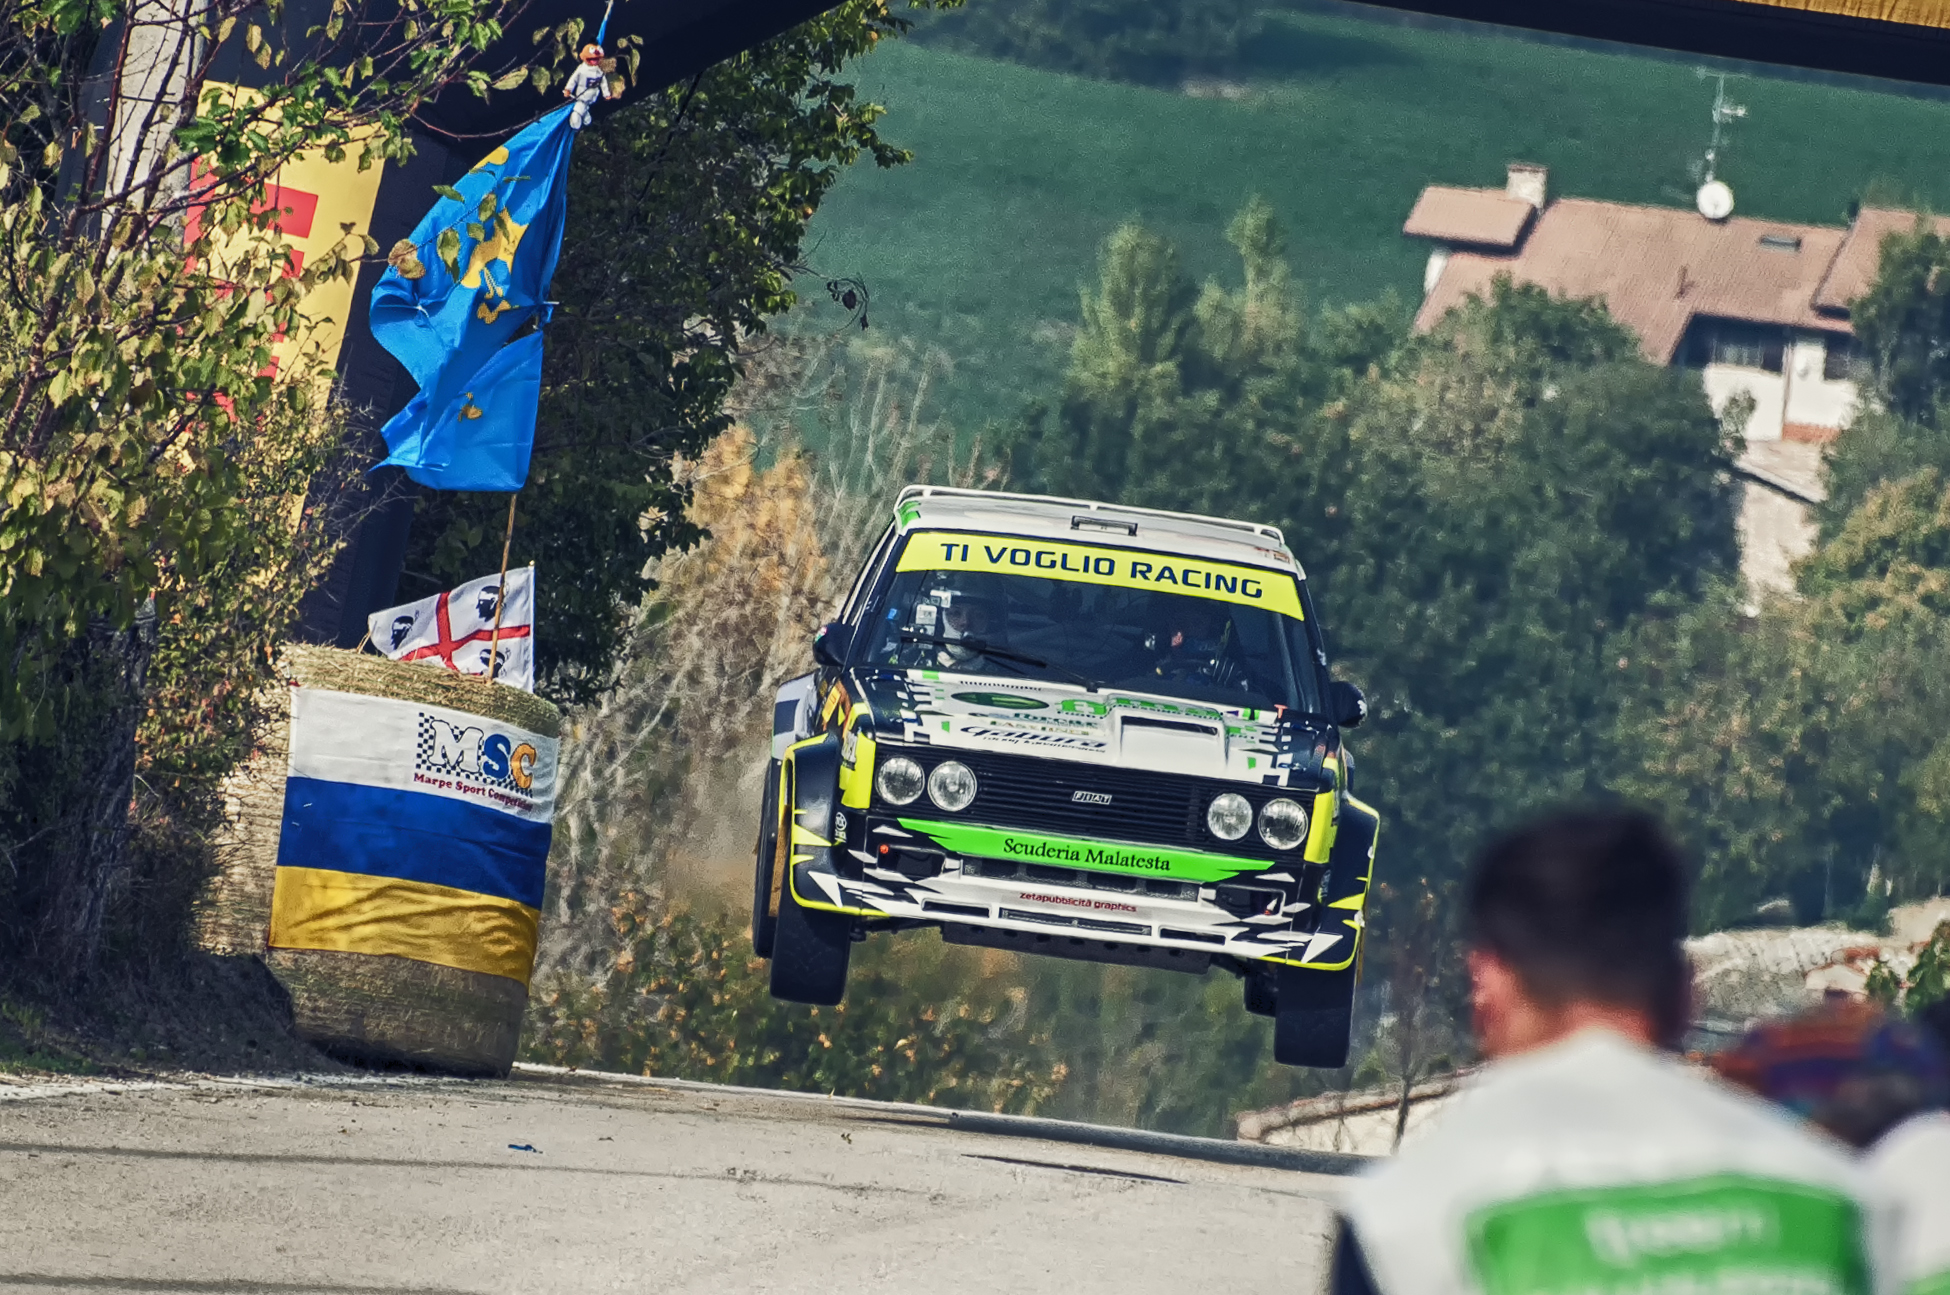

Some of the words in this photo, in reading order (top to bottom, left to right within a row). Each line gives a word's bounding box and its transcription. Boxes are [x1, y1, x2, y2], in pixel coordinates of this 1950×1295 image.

[940, 543, 969, 562] TI
[984, 545, 1116, 577] VOGLIO
[1130, 562, 1263, 599] RACING
[428, 719, 537, 789] MSC
[413, 773, 452, 789] Marpe
[455, 781, 486, 796] Sport
[1003, 838, 1080, 861] Scuderia
[1085, 849, 1171, 871] Malatesta
[1094, 900, 1137, 913] graphics
